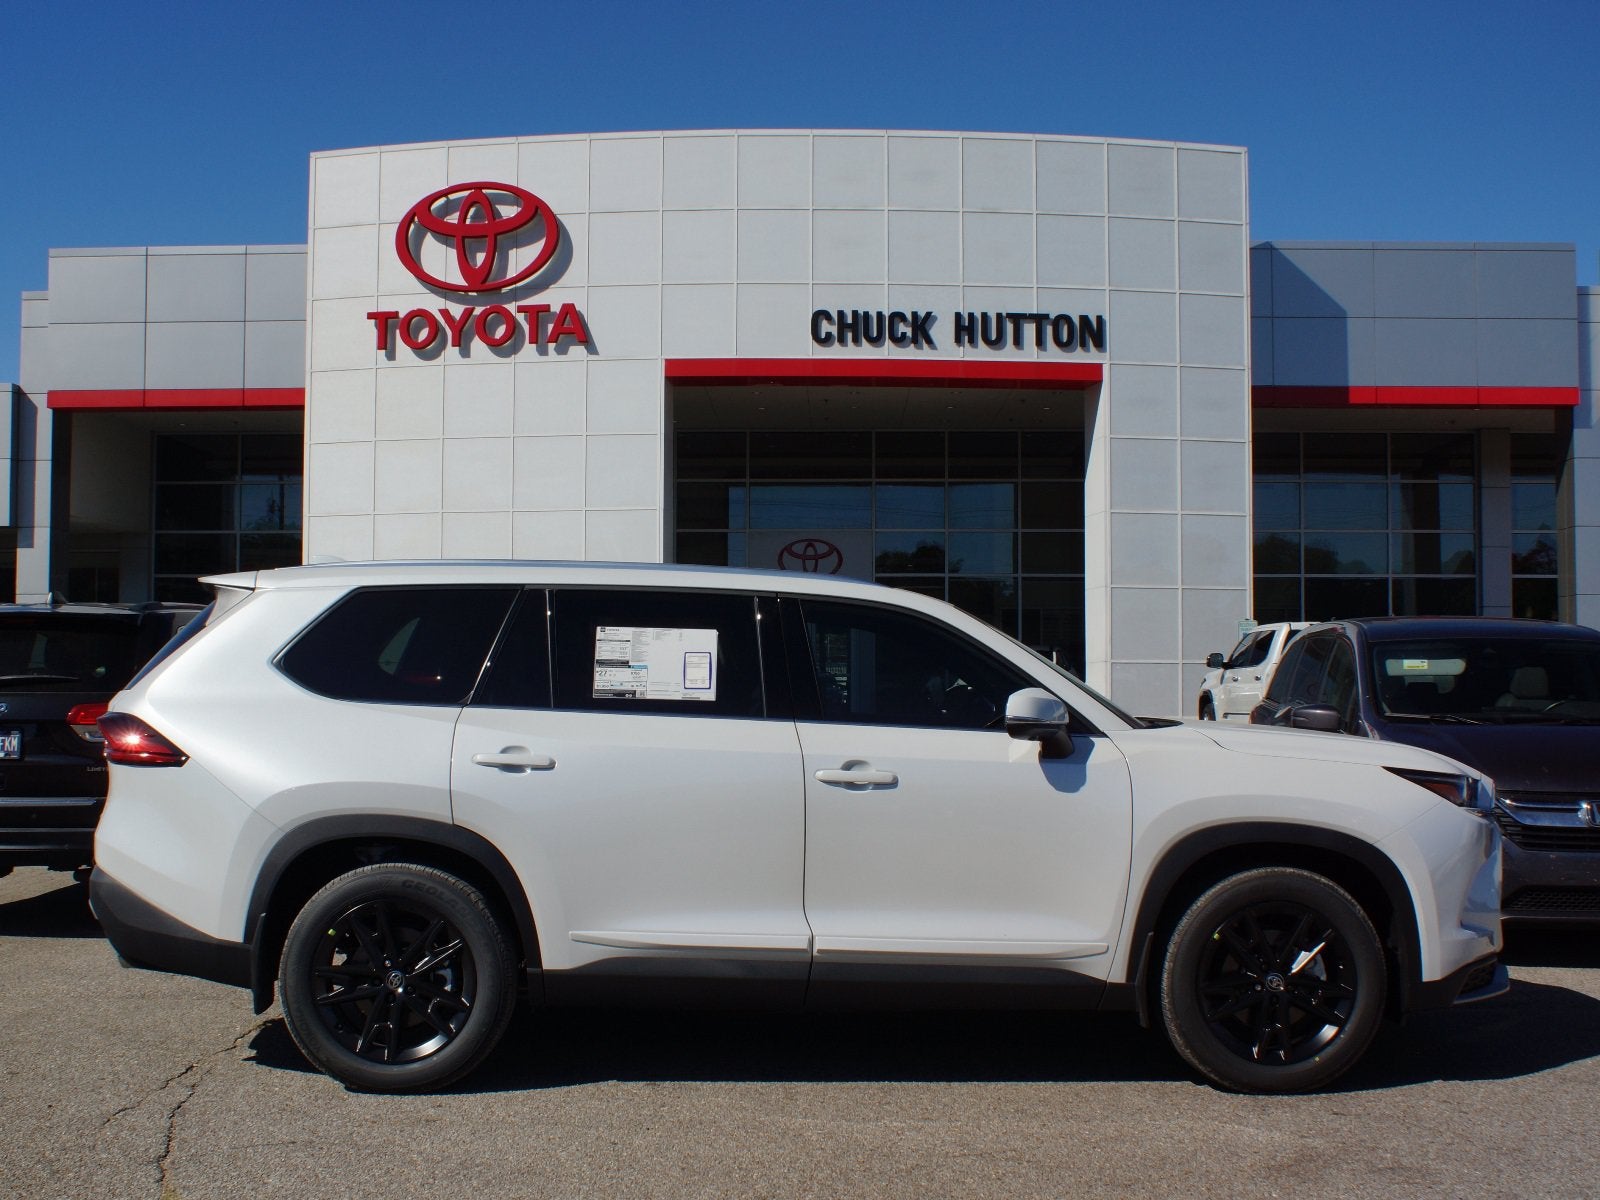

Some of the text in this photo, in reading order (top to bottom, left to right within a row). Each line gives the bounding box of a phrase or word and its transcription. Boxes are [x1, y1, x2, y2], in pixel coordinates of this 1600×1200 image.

[366, 303, 588, 351] TOYOTA
[811, 309, 1104, 348] CHUCK HUTTON
